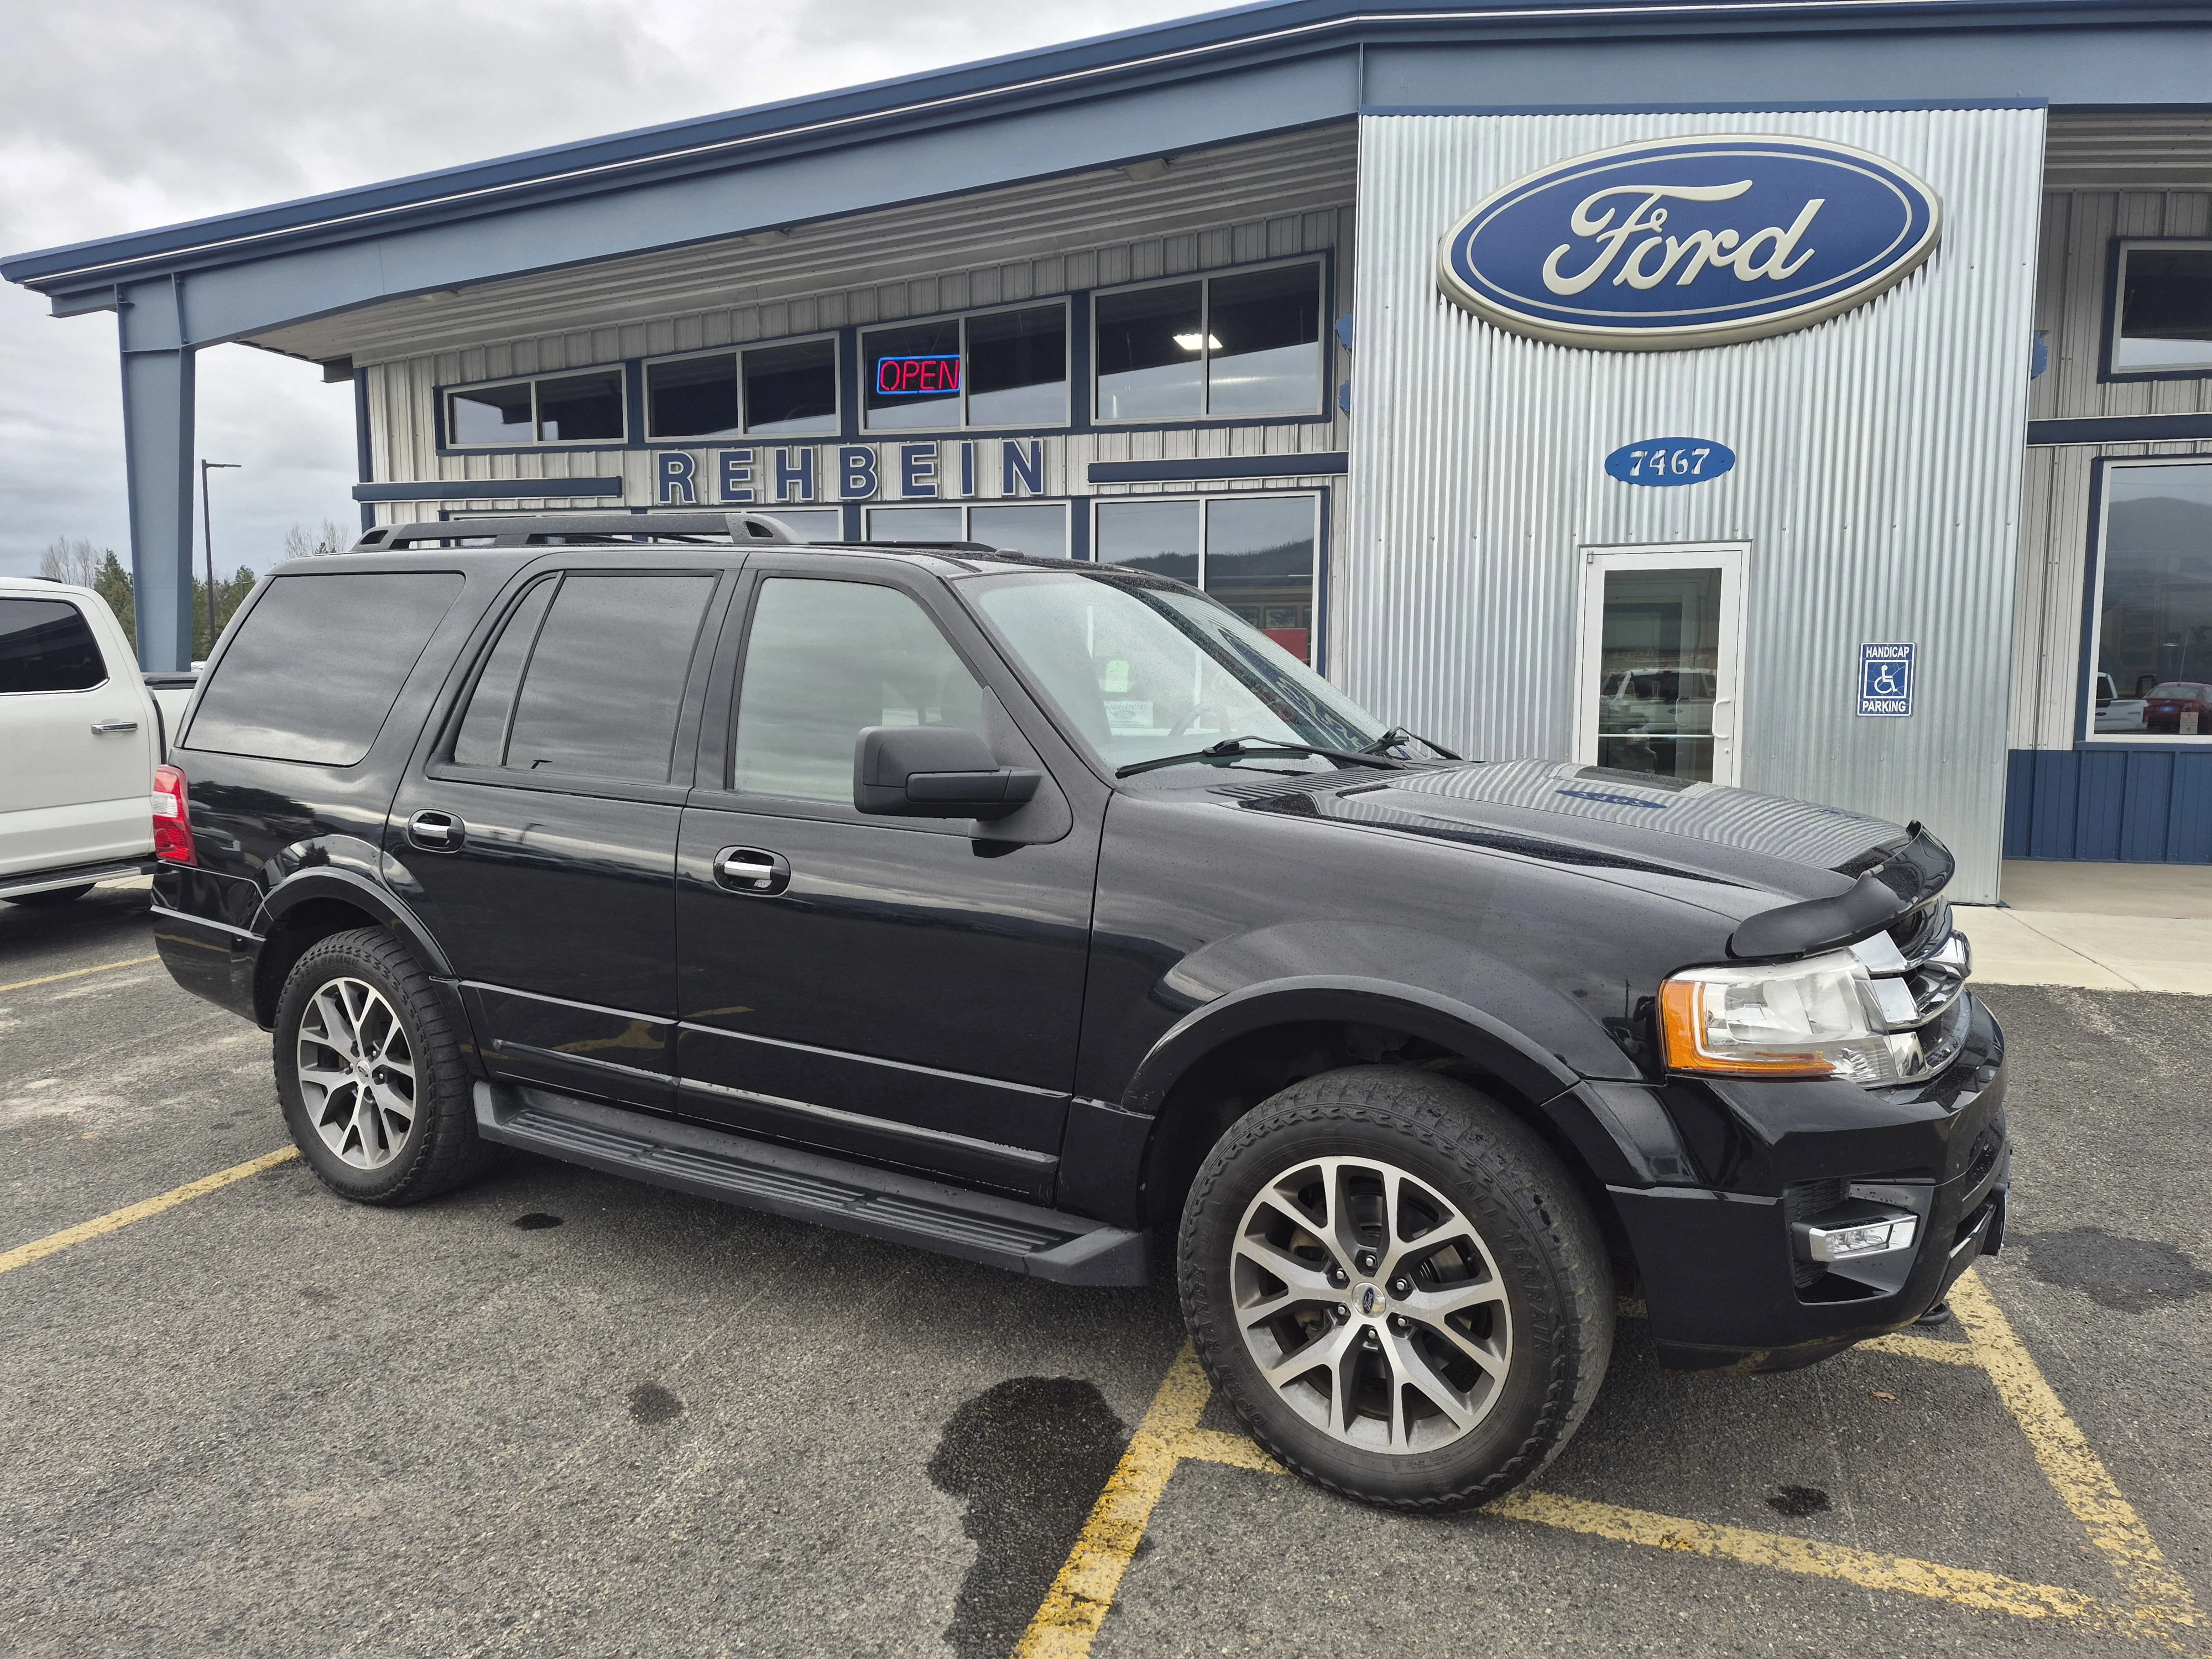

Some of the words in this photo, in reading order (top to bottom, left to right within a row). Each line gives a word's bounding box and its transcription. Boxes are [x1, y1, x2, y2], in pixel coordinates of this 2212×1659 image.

[1543, 180, 1824, 295] Ford
[880, 359, 959, 392] OPEN
[657, 437, 1045, 504] REHBEIN
[1629, 447, 1711, 476] 7467
[1866, 646, 1910, 658] HANDICAP
[1863, 701, 1906, 712] PARKING
[1455, 1178, 1500, 1223] ALL
[1501, 1229, 1552, 1358] TERRAIN
[1193, 1263, 1223, 1353] RANGE
[1364, 1292, 1373, 1311] Ford
[1217, 1364, 1267, 1427] OPEN
